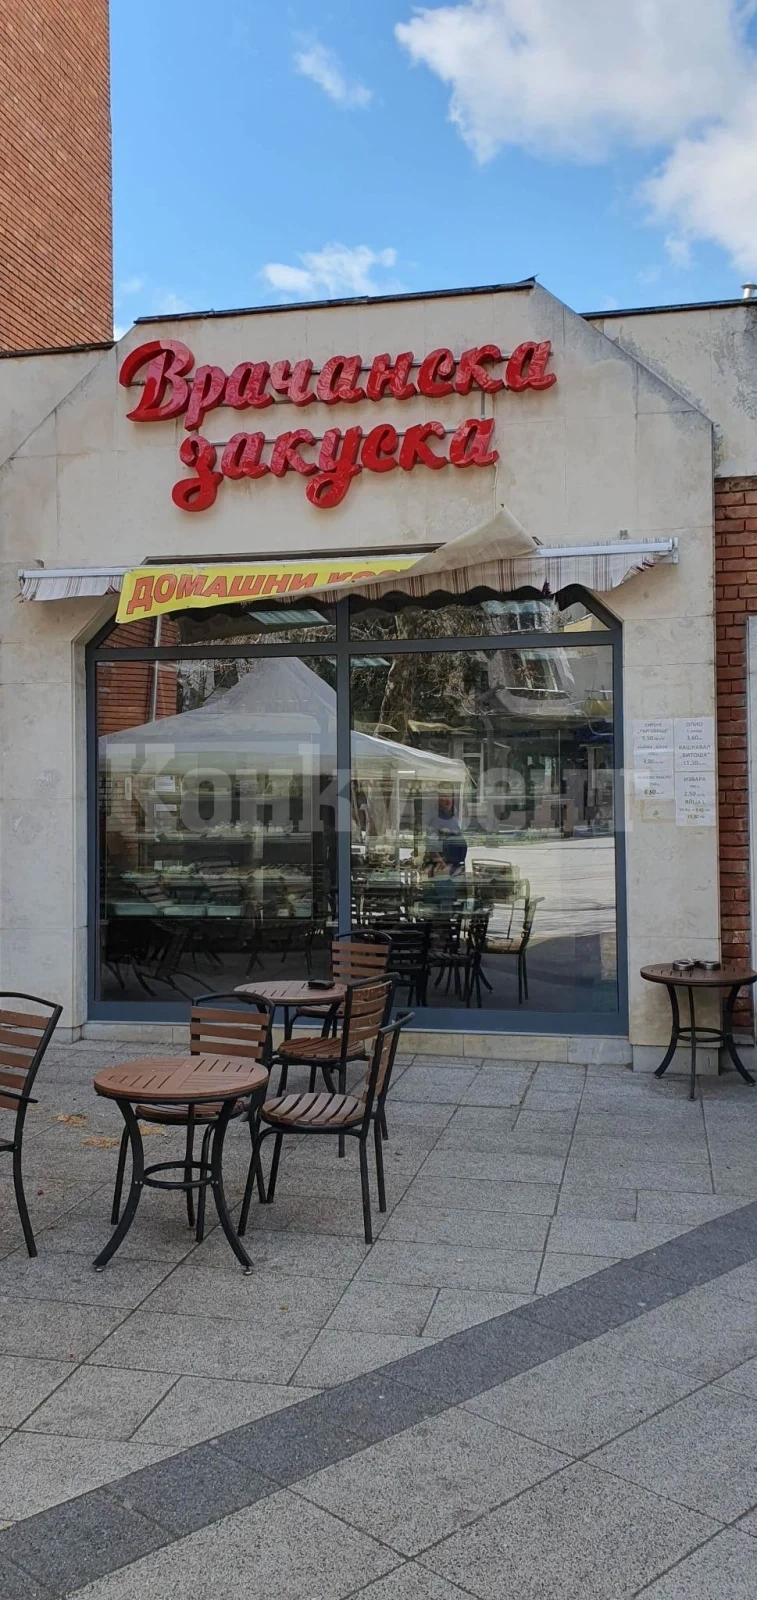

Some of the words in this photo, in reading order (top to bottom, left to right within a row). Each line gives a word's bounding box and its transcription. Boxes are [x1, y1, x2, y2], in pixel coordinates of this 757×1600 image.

[119, 338, 557, 432] Врачанска
[171, 417, 500, 513] закуска
[126, 572, 317, 615] ДОМАШНИ
